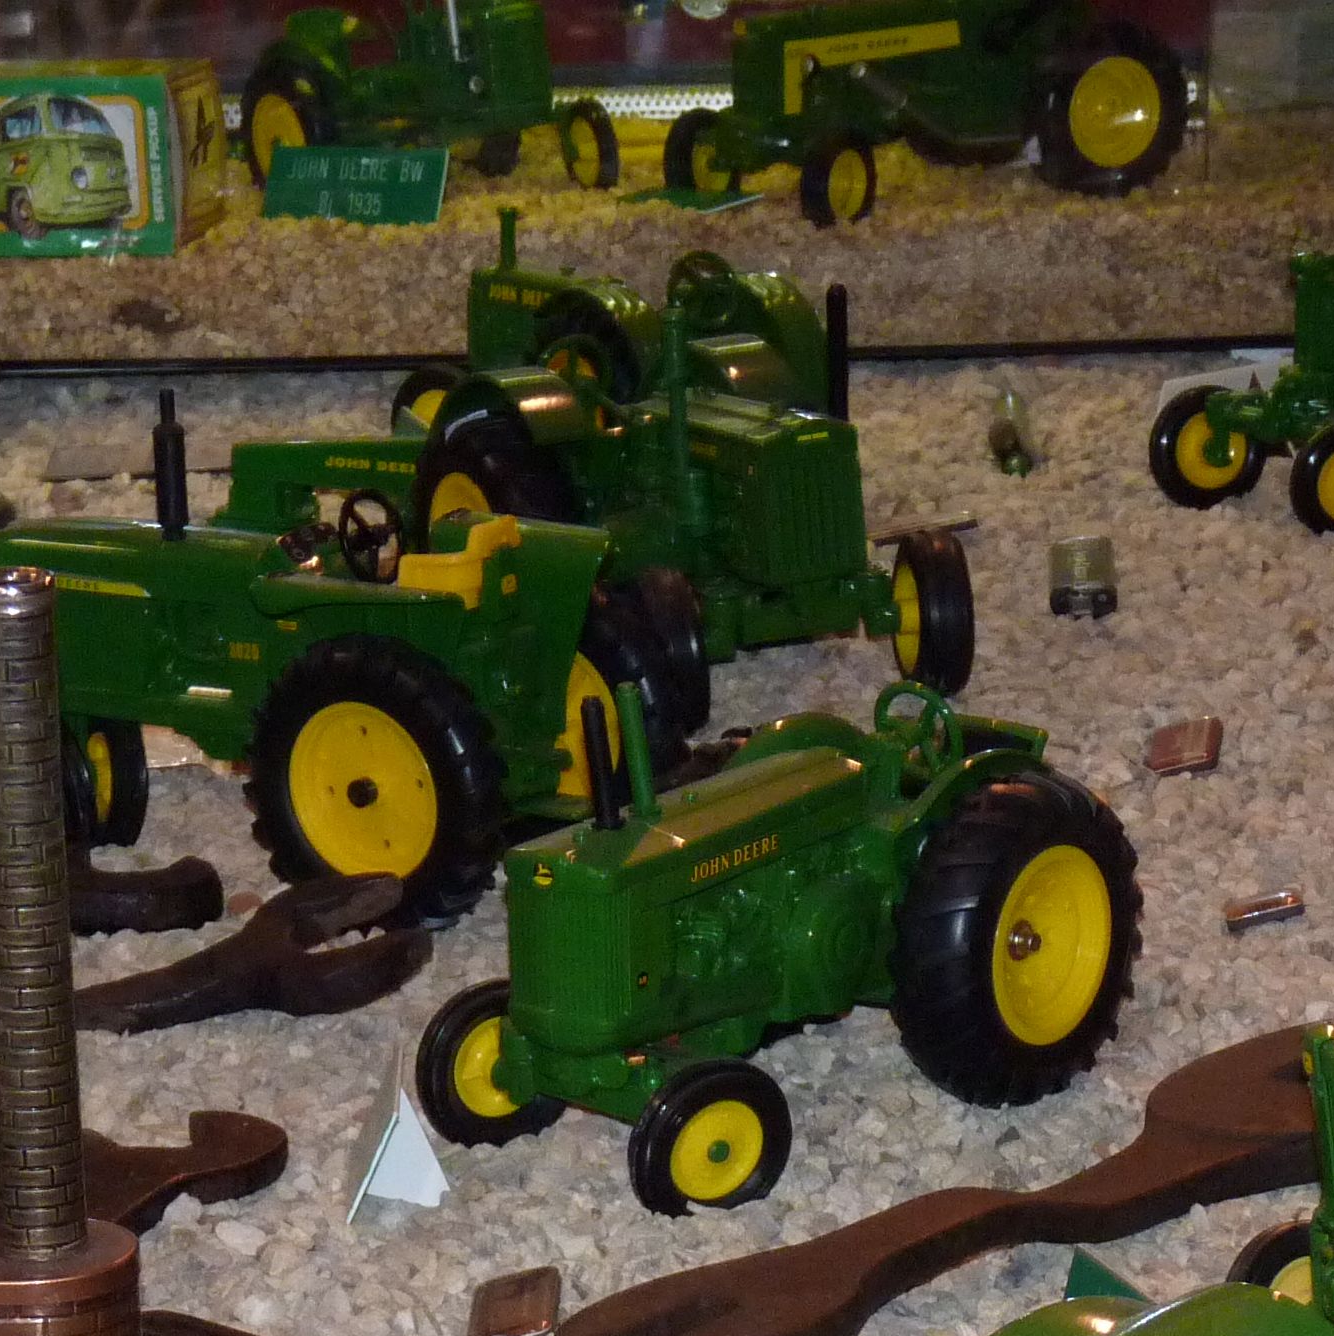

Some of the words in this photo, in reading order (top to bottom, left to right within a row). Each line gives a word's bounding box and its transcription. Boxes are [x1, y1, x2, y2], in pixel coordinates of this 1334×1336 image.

[285, 156, 331, 180] JOHN
[339, 156, 390, 182] DEERE
[399, 158, 425, 183] BW
[347, 192, 383, 217] 1935
[324, 455, 371, 470] JOHN
[690, 853, 730, 884] JOHN
[733, 833, 780, 867] DEERE
